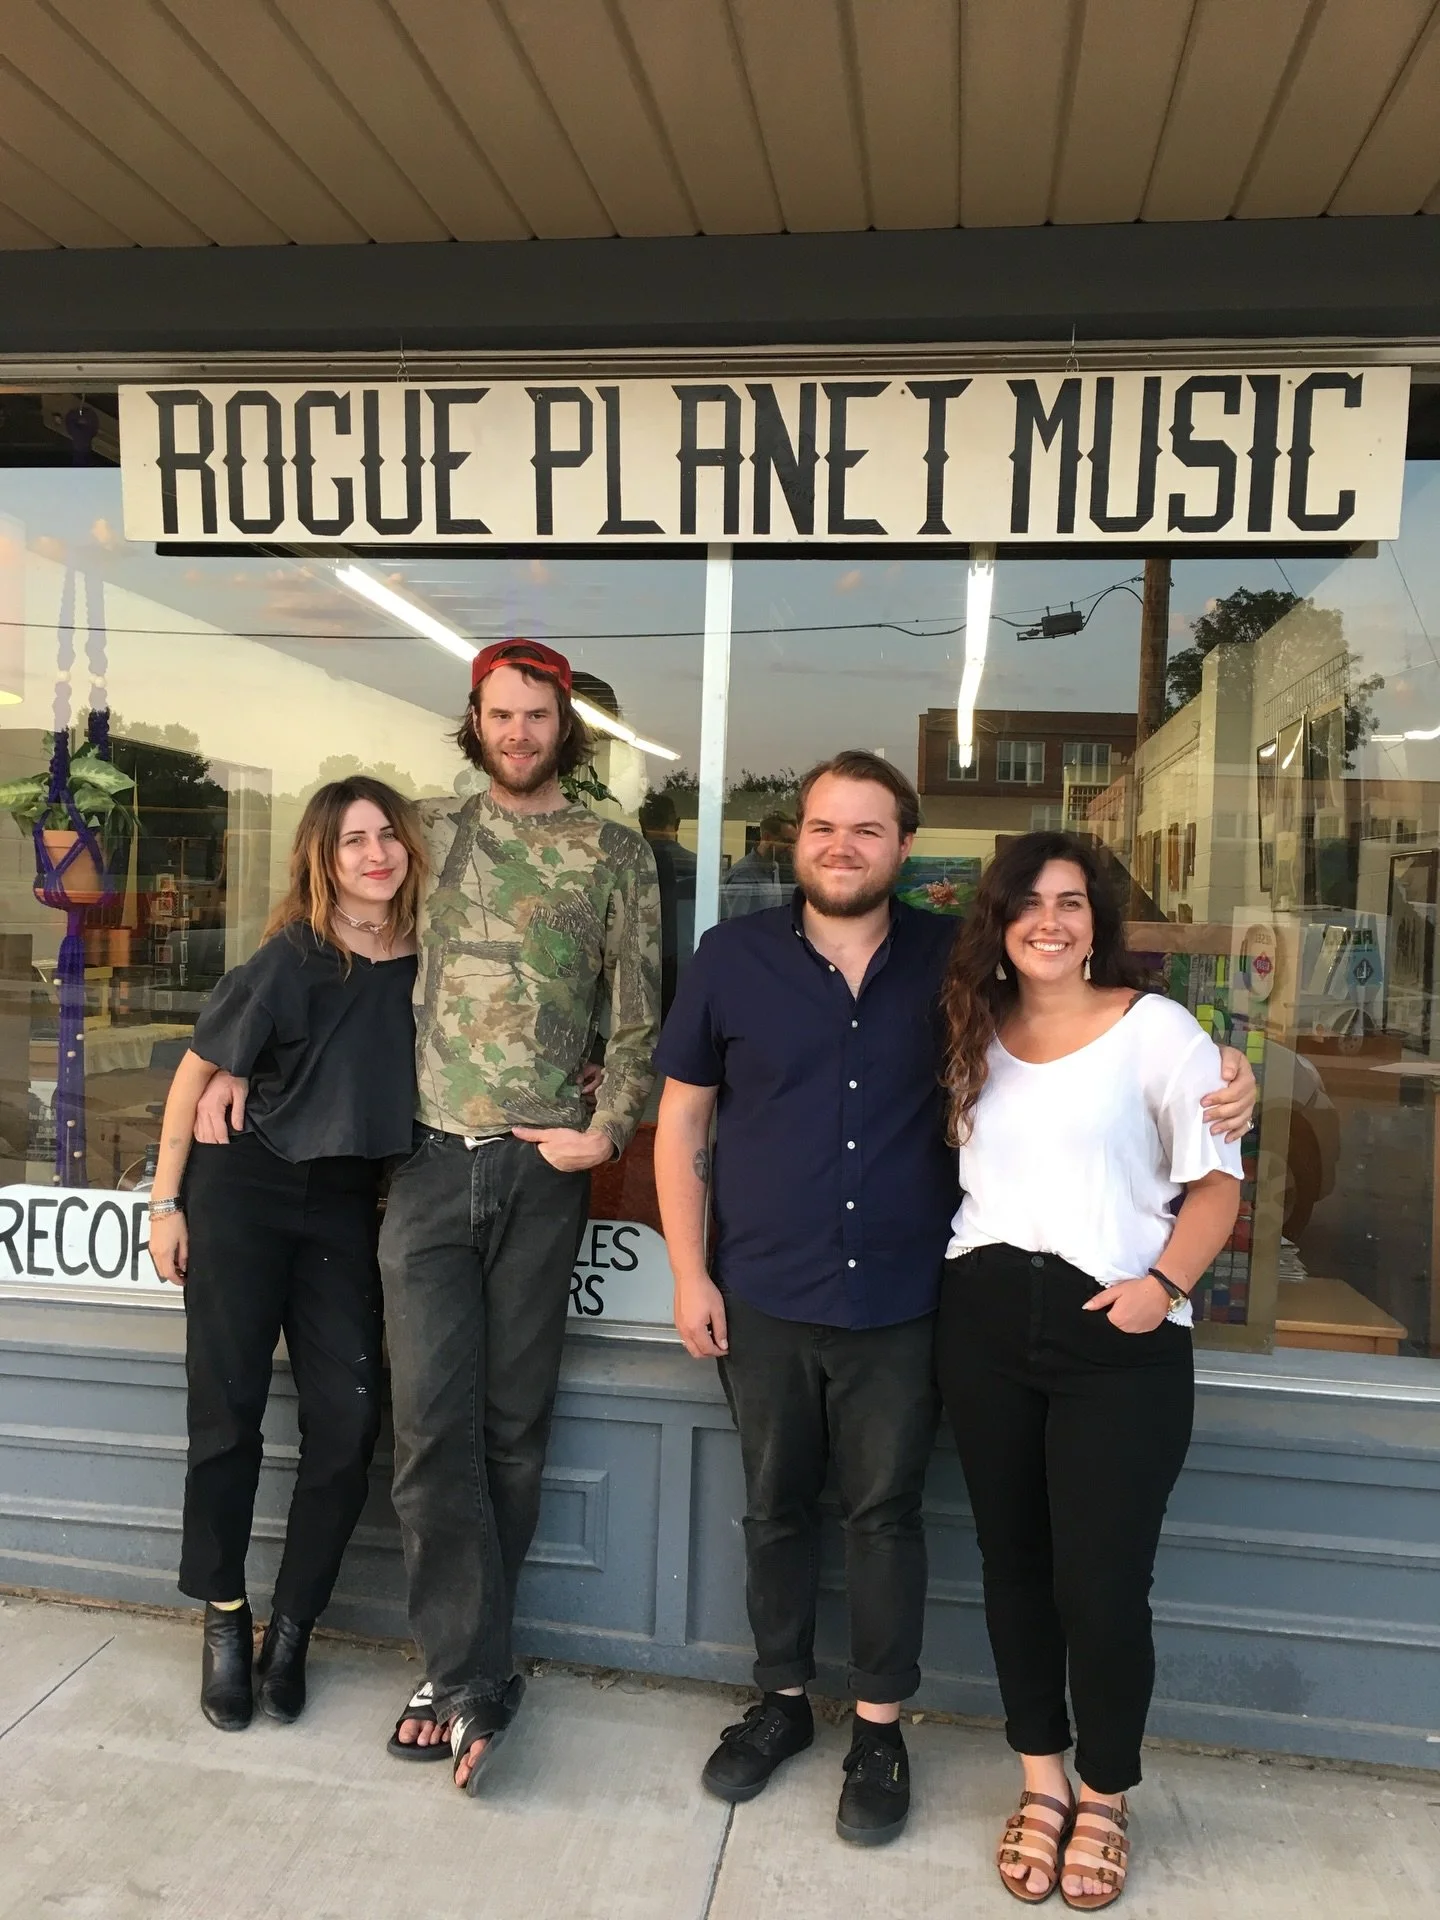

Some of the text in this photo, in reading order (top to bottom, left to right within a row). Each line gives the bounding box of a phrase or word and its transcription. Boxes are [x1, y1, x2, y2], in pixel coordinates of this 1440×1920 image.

[146, 372, 1364, 536] ROGUE PLANET MUSIC
[574, 1225, 640, 1271] ES
